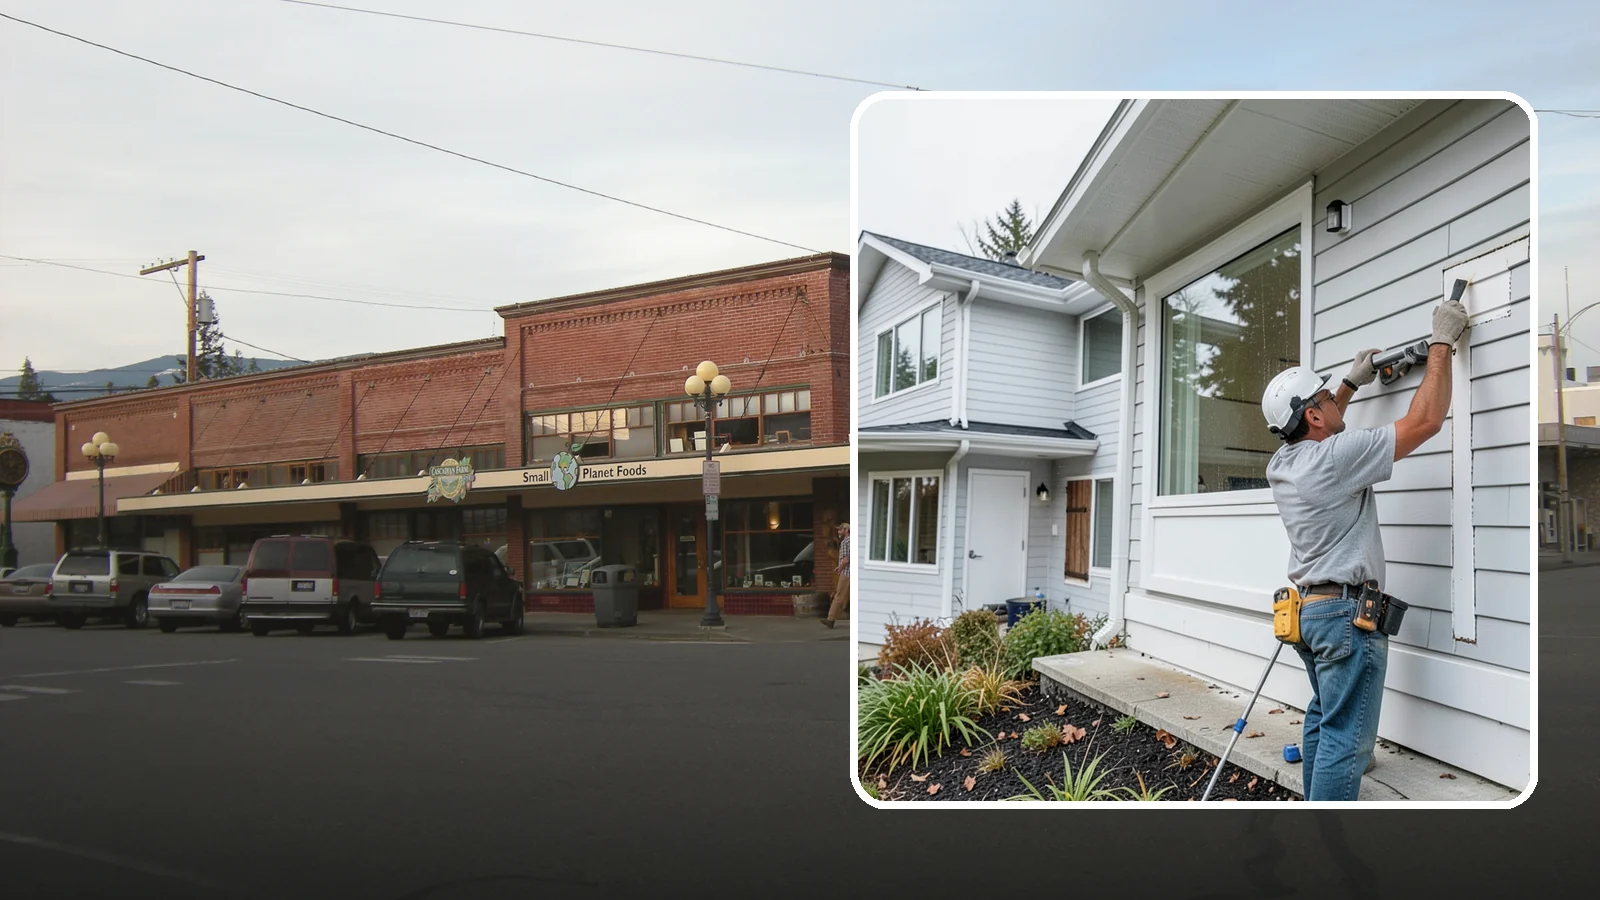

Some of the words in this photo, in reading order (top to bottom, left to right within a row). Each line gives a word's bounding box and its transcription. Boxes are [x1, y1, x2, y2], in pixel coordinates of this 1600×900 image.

[523, 470, 549, 483] Small
[583, 467, 614, 479] Planet
[617, 464, 647, 477] Foods
